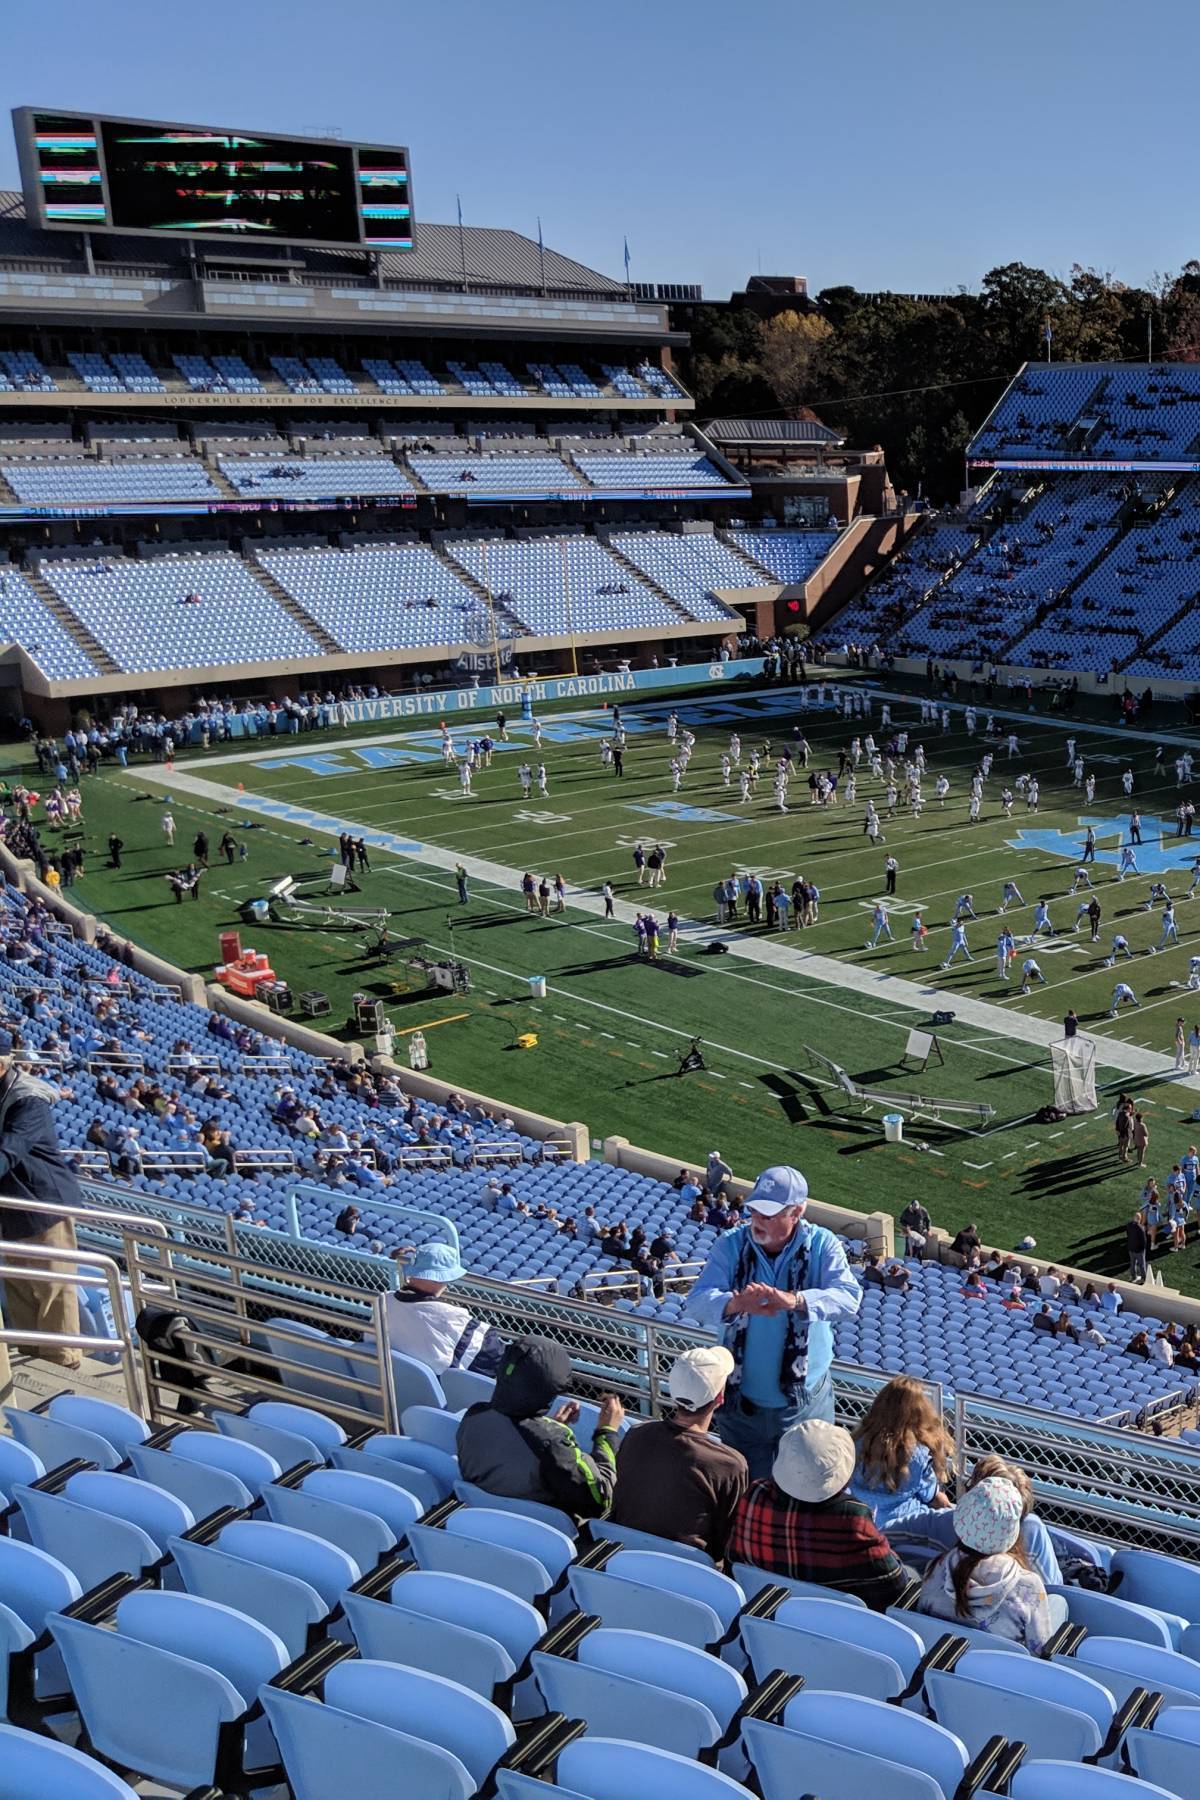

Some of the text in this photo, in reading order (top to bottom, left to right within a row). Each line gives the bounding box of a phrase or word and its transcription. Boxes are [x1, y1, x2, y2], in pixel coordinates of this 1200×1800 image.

[164, 396, 399, 406] LOUDERMILK CENTER FOR EXCELLENCE
[457, 649, 512, 672] Allstate
[329, 673, 637, 725] UNIVERSITY OF NORTH CAROLINA
